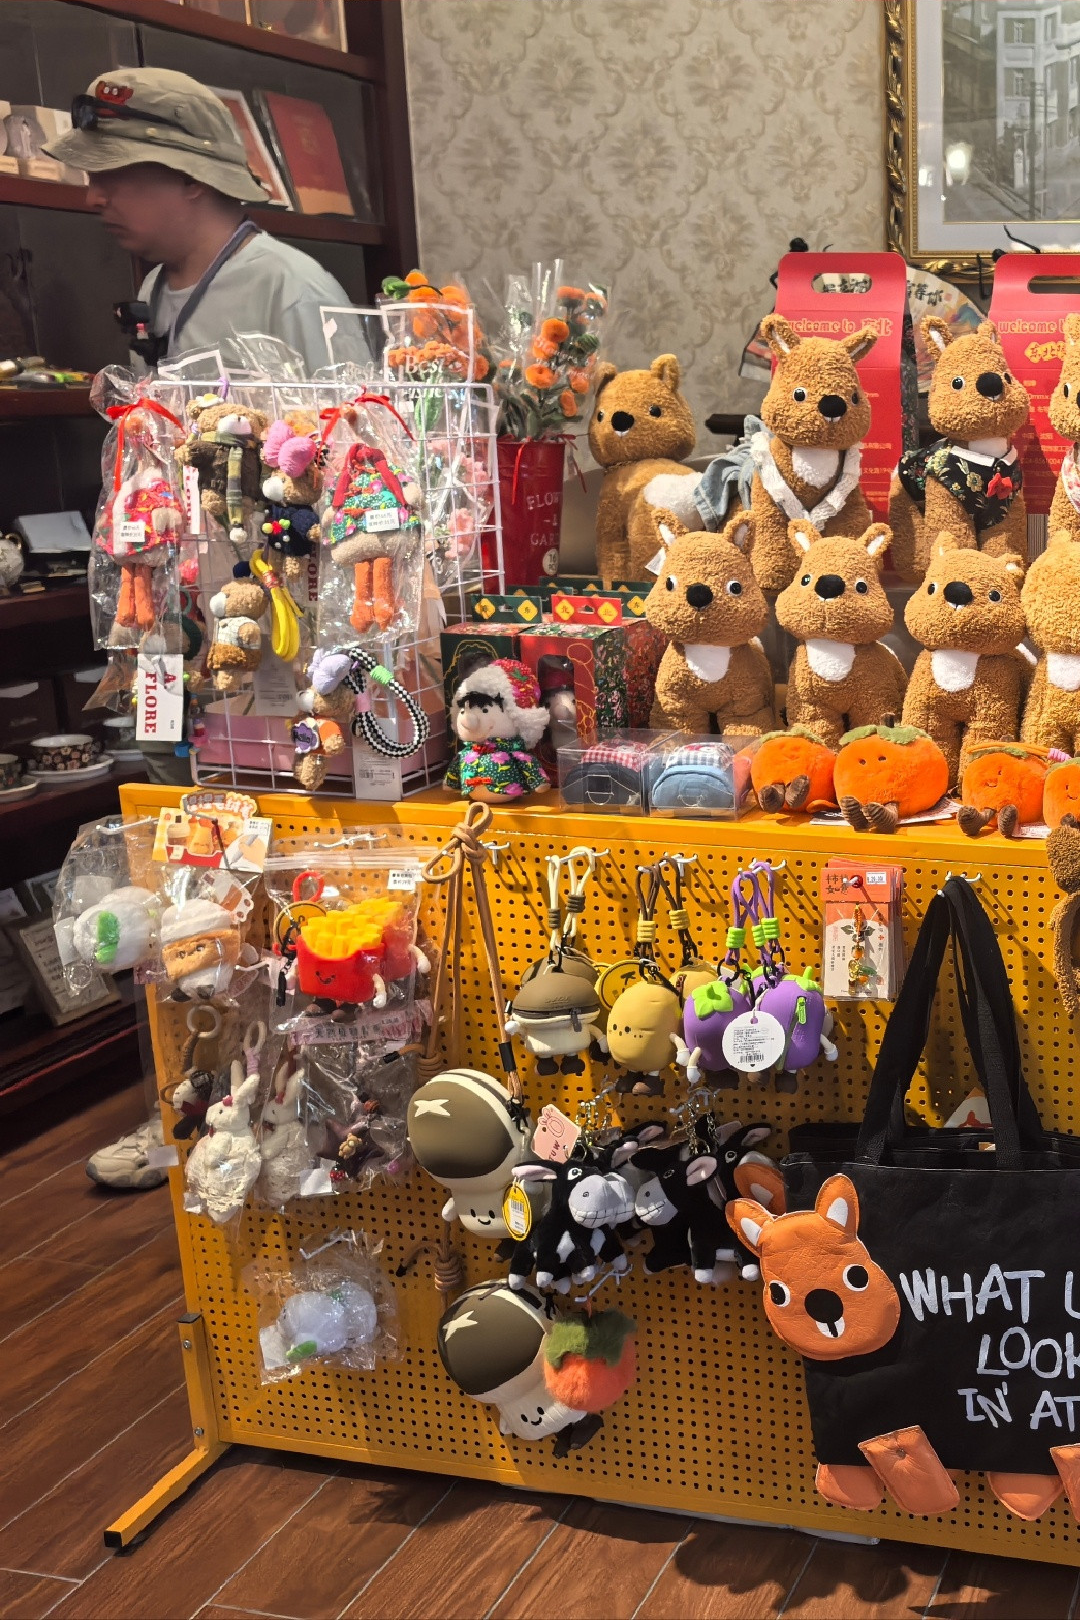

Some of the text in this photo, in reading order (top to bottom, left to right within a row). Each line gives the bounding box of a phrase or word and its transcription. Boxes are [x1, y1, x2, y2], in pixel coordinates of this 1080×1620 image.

[998, 317, 1057, 334] welcome
[144, 671, 159, 734] FLORE
[898, 1263, 1046, 1323] WHAT
